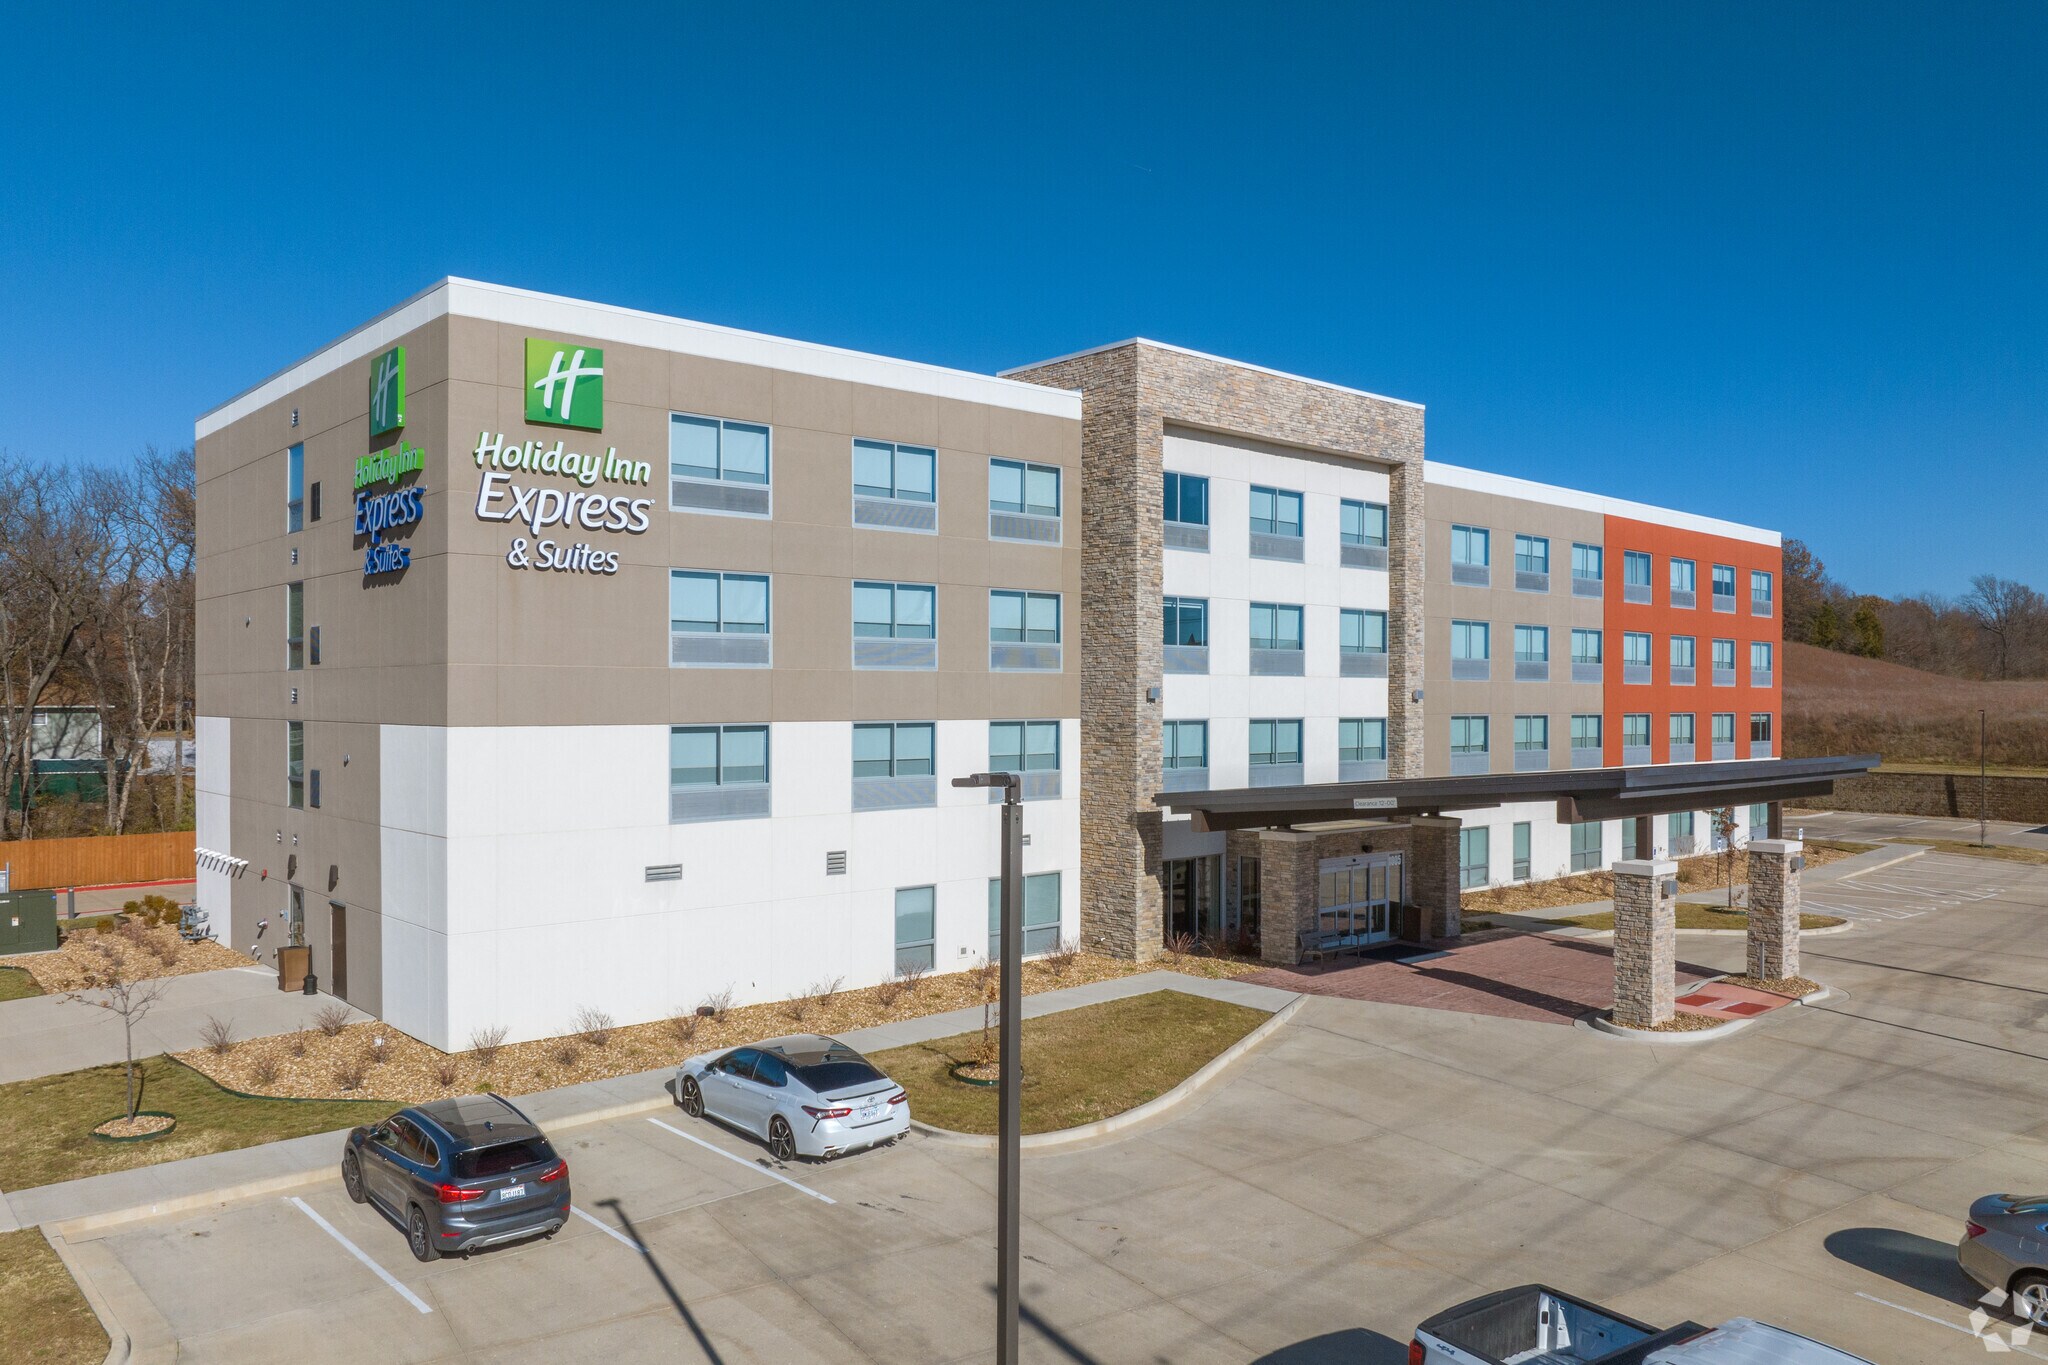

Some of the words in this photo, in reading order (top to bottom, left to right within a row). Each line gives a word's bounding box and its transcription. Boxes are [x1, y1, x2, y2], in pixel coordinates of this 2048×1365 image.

[354, 449, 399, 488] Holiday
[398, 441, 422, 474] Inn
[473, 432, 602, 487] Holiday
[603, 447, 651, 484] Inn
[354, 487, 422, 544] Express
[476, 472, 652, 535] Express
[364, 549, 373, 575] &
[373, 544, 408, 573] Suites
[507, 537, 529, 568] &
[534, 539, 619, 573] Suites
